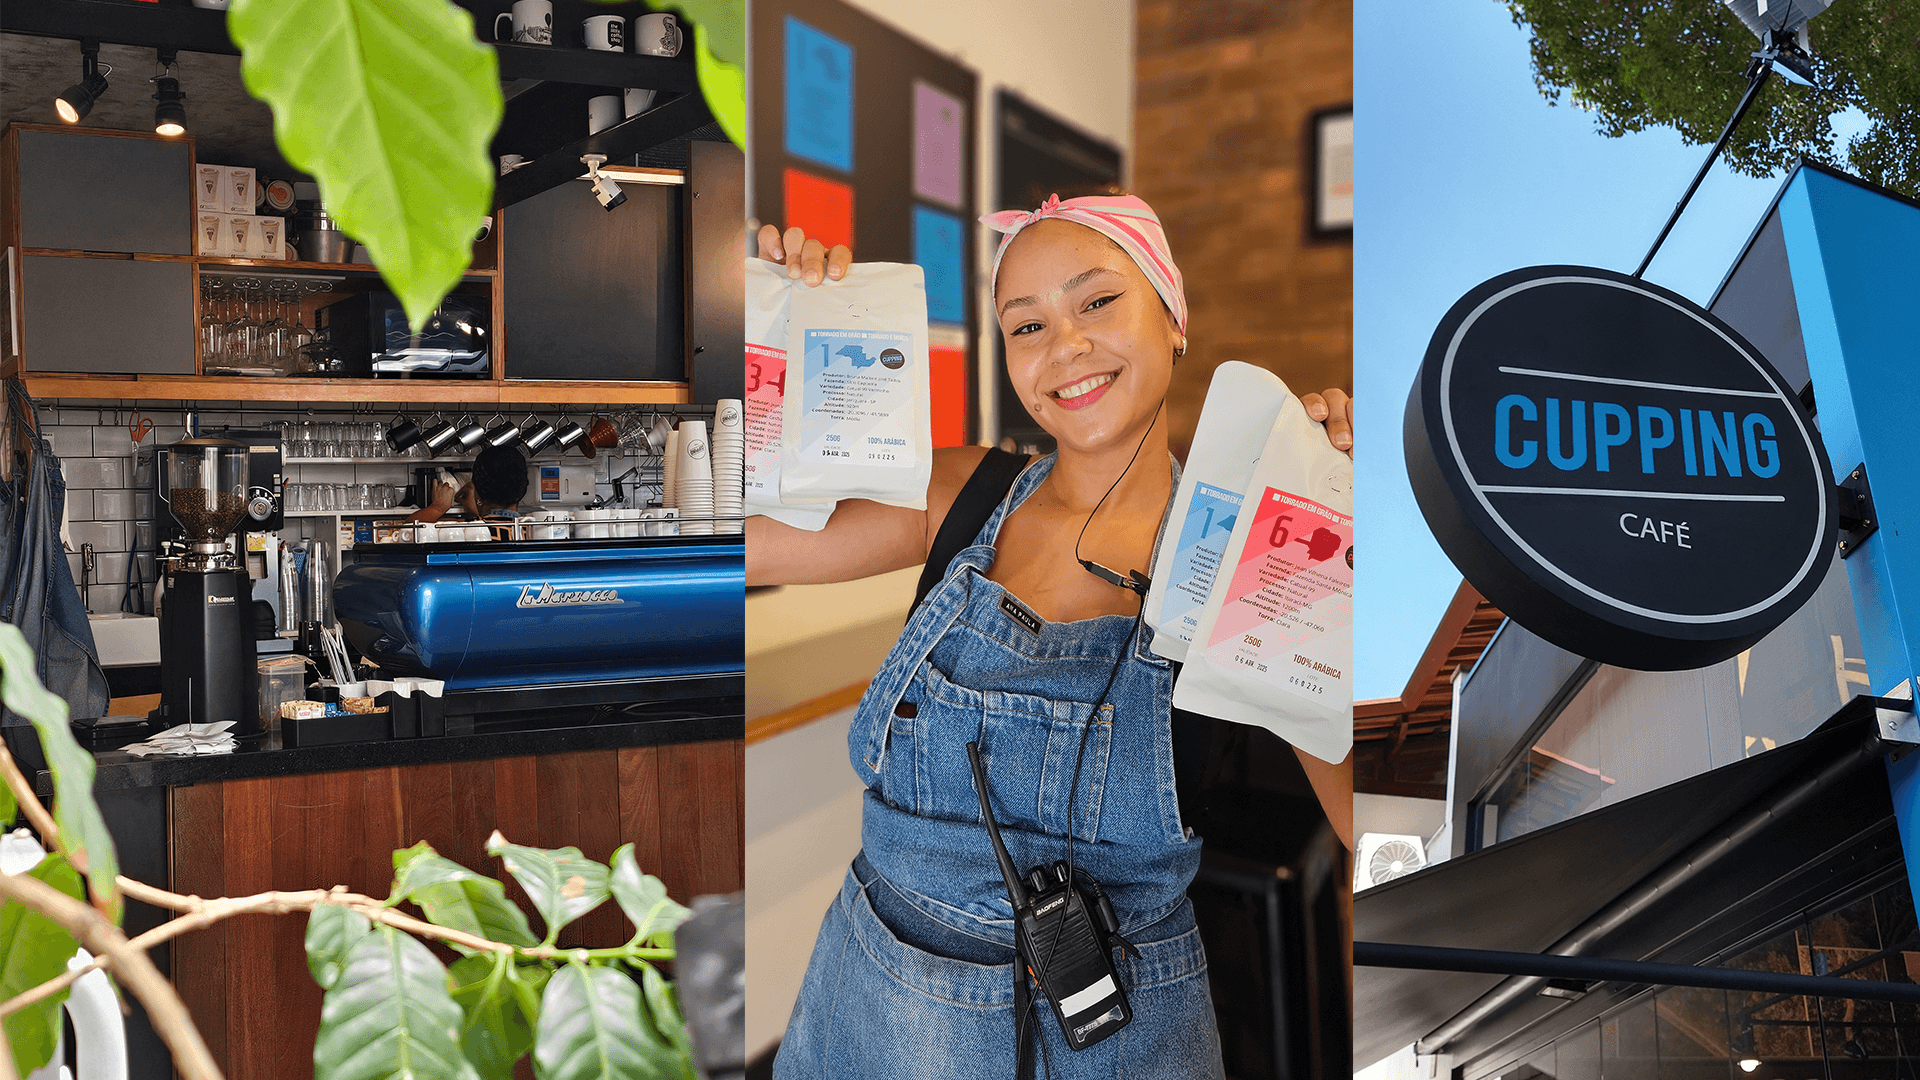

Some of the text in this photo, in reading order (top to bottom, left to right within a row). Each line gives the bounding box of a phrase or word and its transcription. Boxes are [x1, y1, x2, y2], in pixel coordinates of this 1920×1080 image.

[821, 344, 829, 367] 1
[747, 362, 762, 392] 3
[825, 434, 841, 442] 250G
[868, 437, 883, 445] 100%
[1494, 394, 1781, 479] CUPPING
[1280, 494, 1308, 510] TORRADO
[1306, 503, 1318, 514] EM
[1317, 507, 1333, 520] GRÃO
[1200, 506, 1215, 539] 1
[1269, 514, 1294, 549] 6
[1619, 512, 1692, 549] CAFÉ
[1266, 553, 1294, 568] Produtor:
[1258, 567, 1290, 583] Variedade:
[1265, 561, 1292, 575] Fazenda:
[1292, 572, 1316, 584] Fazenda
[1316, 580, 1332, 590] Santa
[536, 581, 618, 604] Marzocco
[1258, 576, 1309, 599] Processo: Natural
[1261, 586, 1284, 599] Cidade:
[1239, 596, 1279, 615] Coordenadas:
[1255, 593, 1301, 615] Altitude: 1200m
[1005, 603, 1036, 629] ANA PAULA
[1257, 611, 1291, 629] Torra: Clara
[1243, 634, 1263, 648] 250G
[1293, 653, 1342, 680] 100% ARÁBICA
[1036, 897, 1065, 916] BAOFENG
